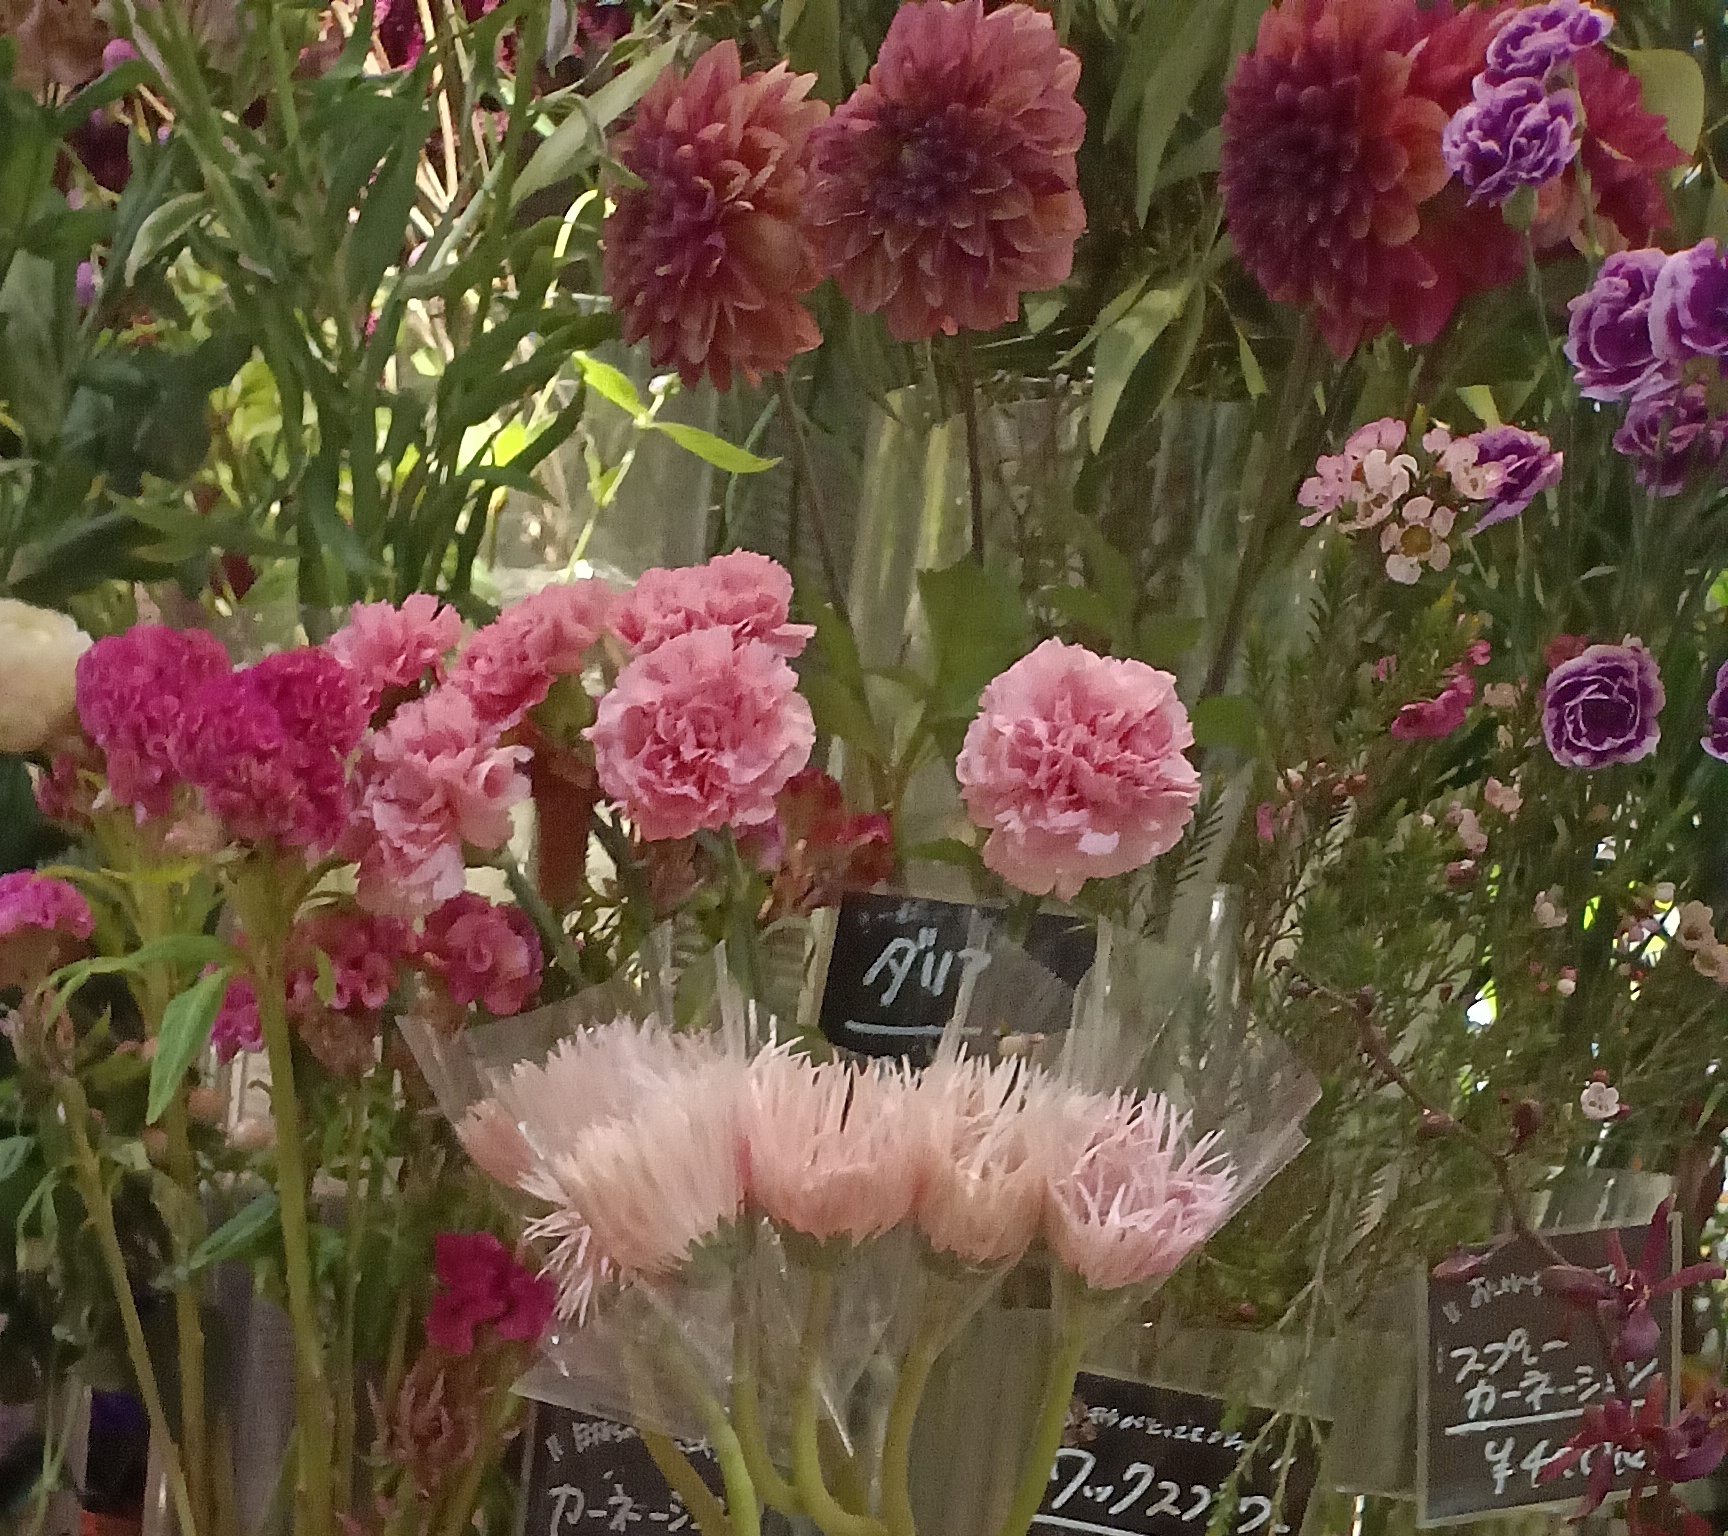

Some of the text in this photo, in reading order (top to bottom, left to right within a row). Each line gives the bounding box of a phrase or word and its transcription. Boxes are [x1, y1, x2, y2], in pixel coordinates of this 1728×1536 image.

[861, 926, 993, 1008] ダリア
[1448, 1328, 1570, 1385] スプレー
[1050, 1446, 1292, 1535] ワックスフワー
